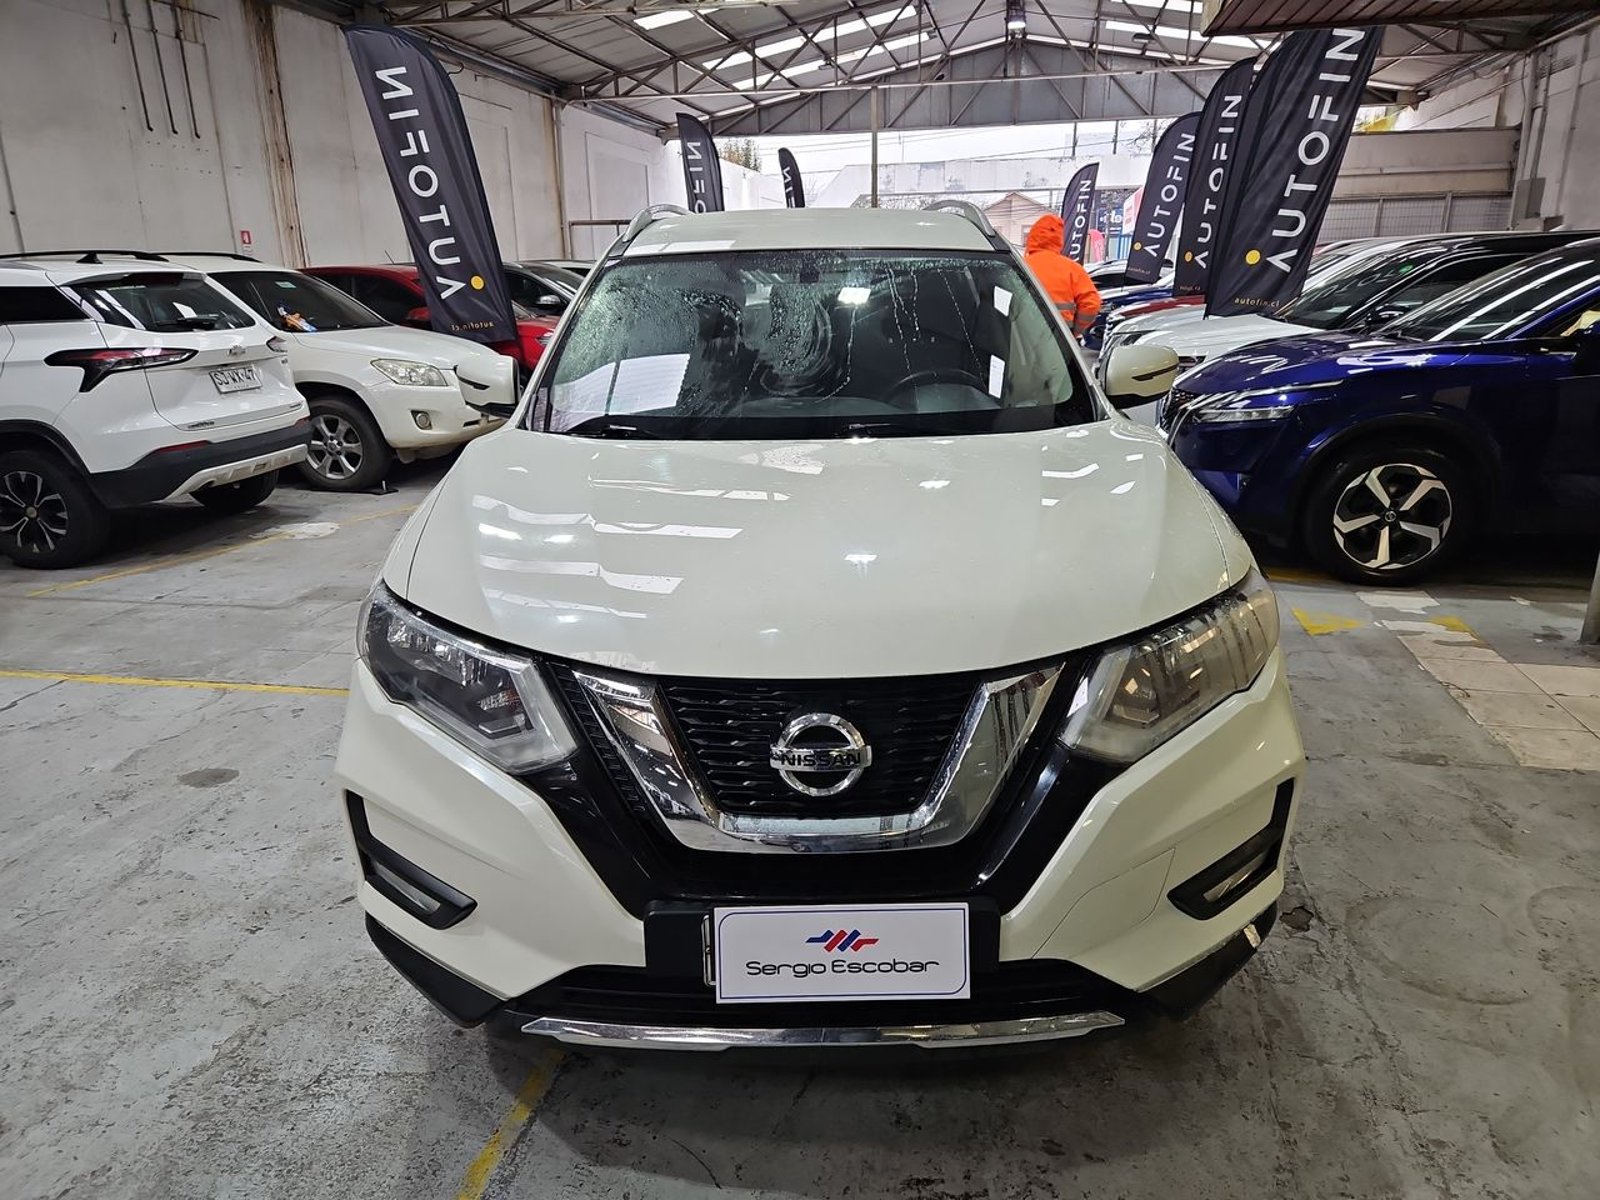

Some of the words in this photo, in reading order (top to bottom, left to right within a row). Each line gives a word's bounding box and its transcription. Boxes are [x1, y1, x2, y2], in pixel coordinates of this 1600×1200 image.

[1143, 133, 1196, 257] AUTOFIN
[1194, 95, 1242, 269] AUTOFIN
[1266, 28, 1366, 273] AUTOFIN
[780, 752, 861, 767] NISSAN
[746, 961, 827, 978] Sergio
[831, 959, 940, 974] Escobar
